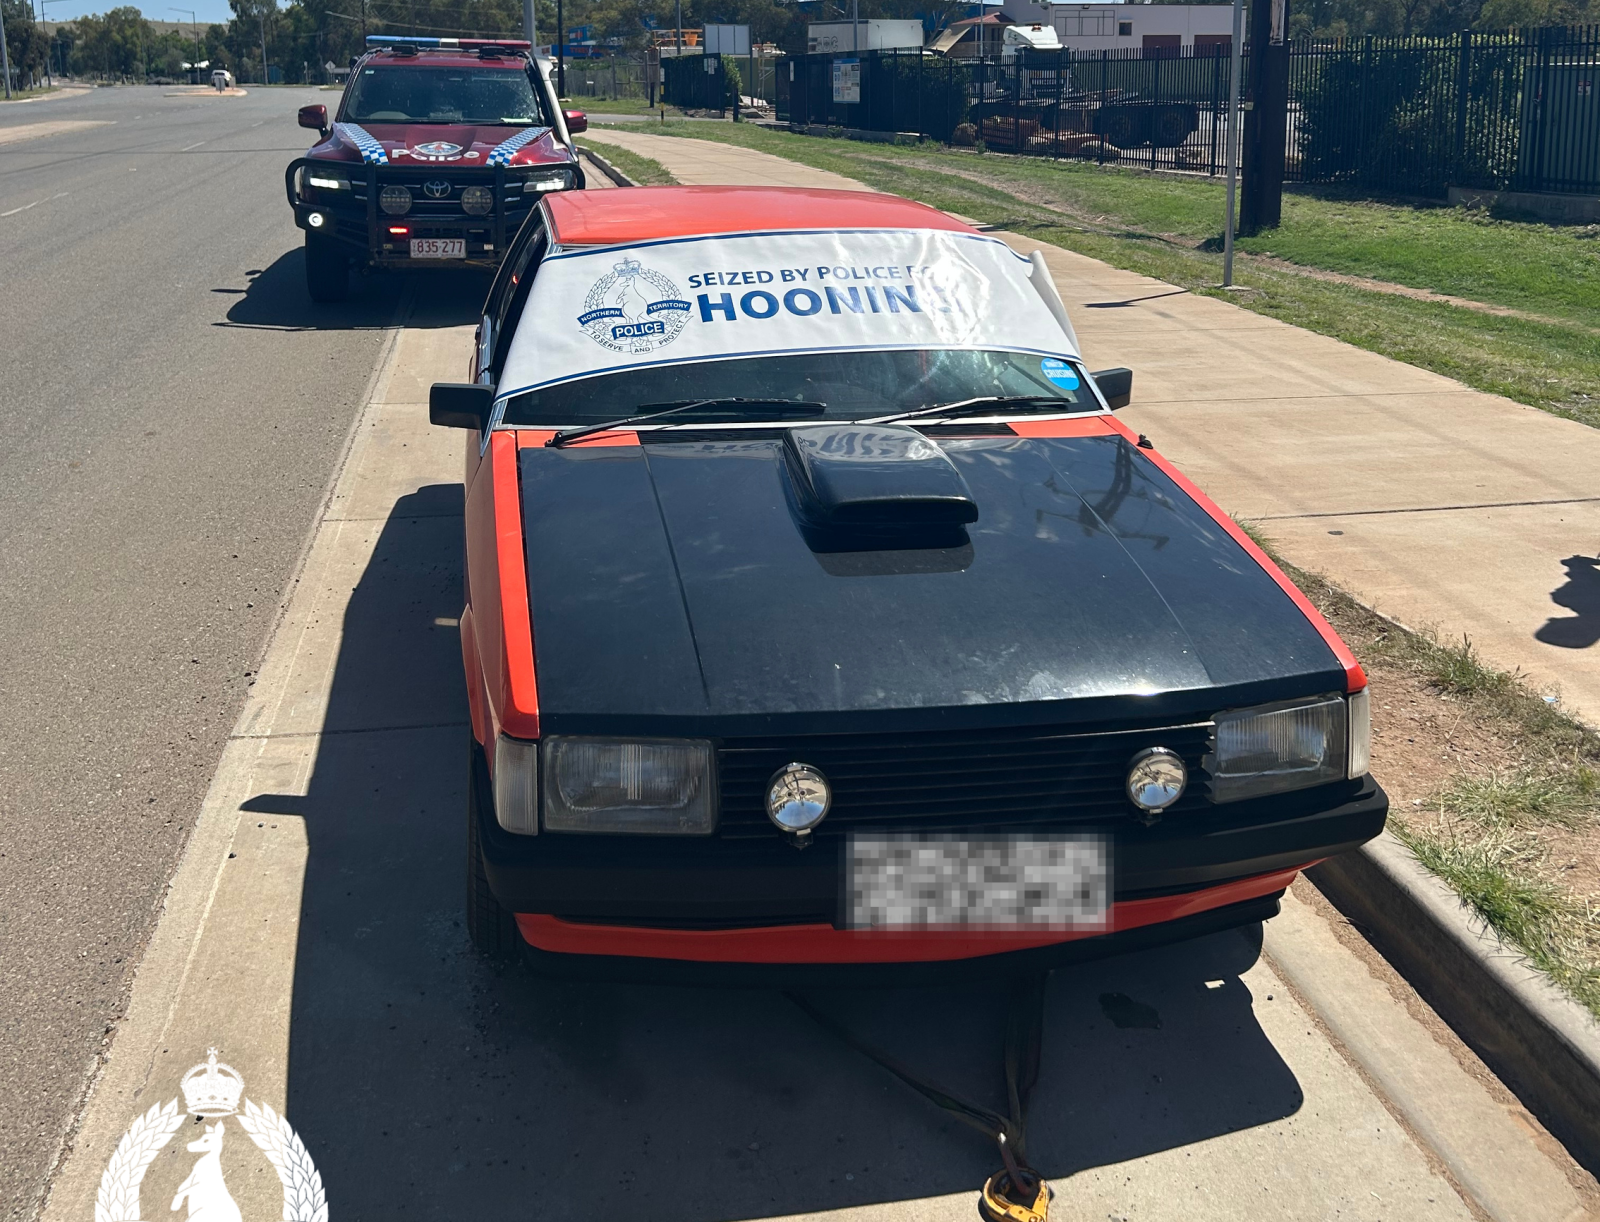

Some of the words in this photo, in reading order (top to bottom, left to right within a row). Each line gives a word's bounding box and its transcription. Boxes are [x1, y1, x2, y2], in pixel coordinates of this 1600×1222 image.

[688, 270, 774, 289] SEIZED
[780, 268, 809, 283] BY
[816, 265, 903, 280] POLICE
[580, 310, 621, 323] NORTHERN
[648, 302, 688, 312] TERRITORY
[590, 330, 600, 340] TO
[598, 336, 624, 352] SERVE
[633, 346, 651, 354] AND
[658, 320, 685, 346] PROTECT
[615, 322, 663, 337] POLICE
